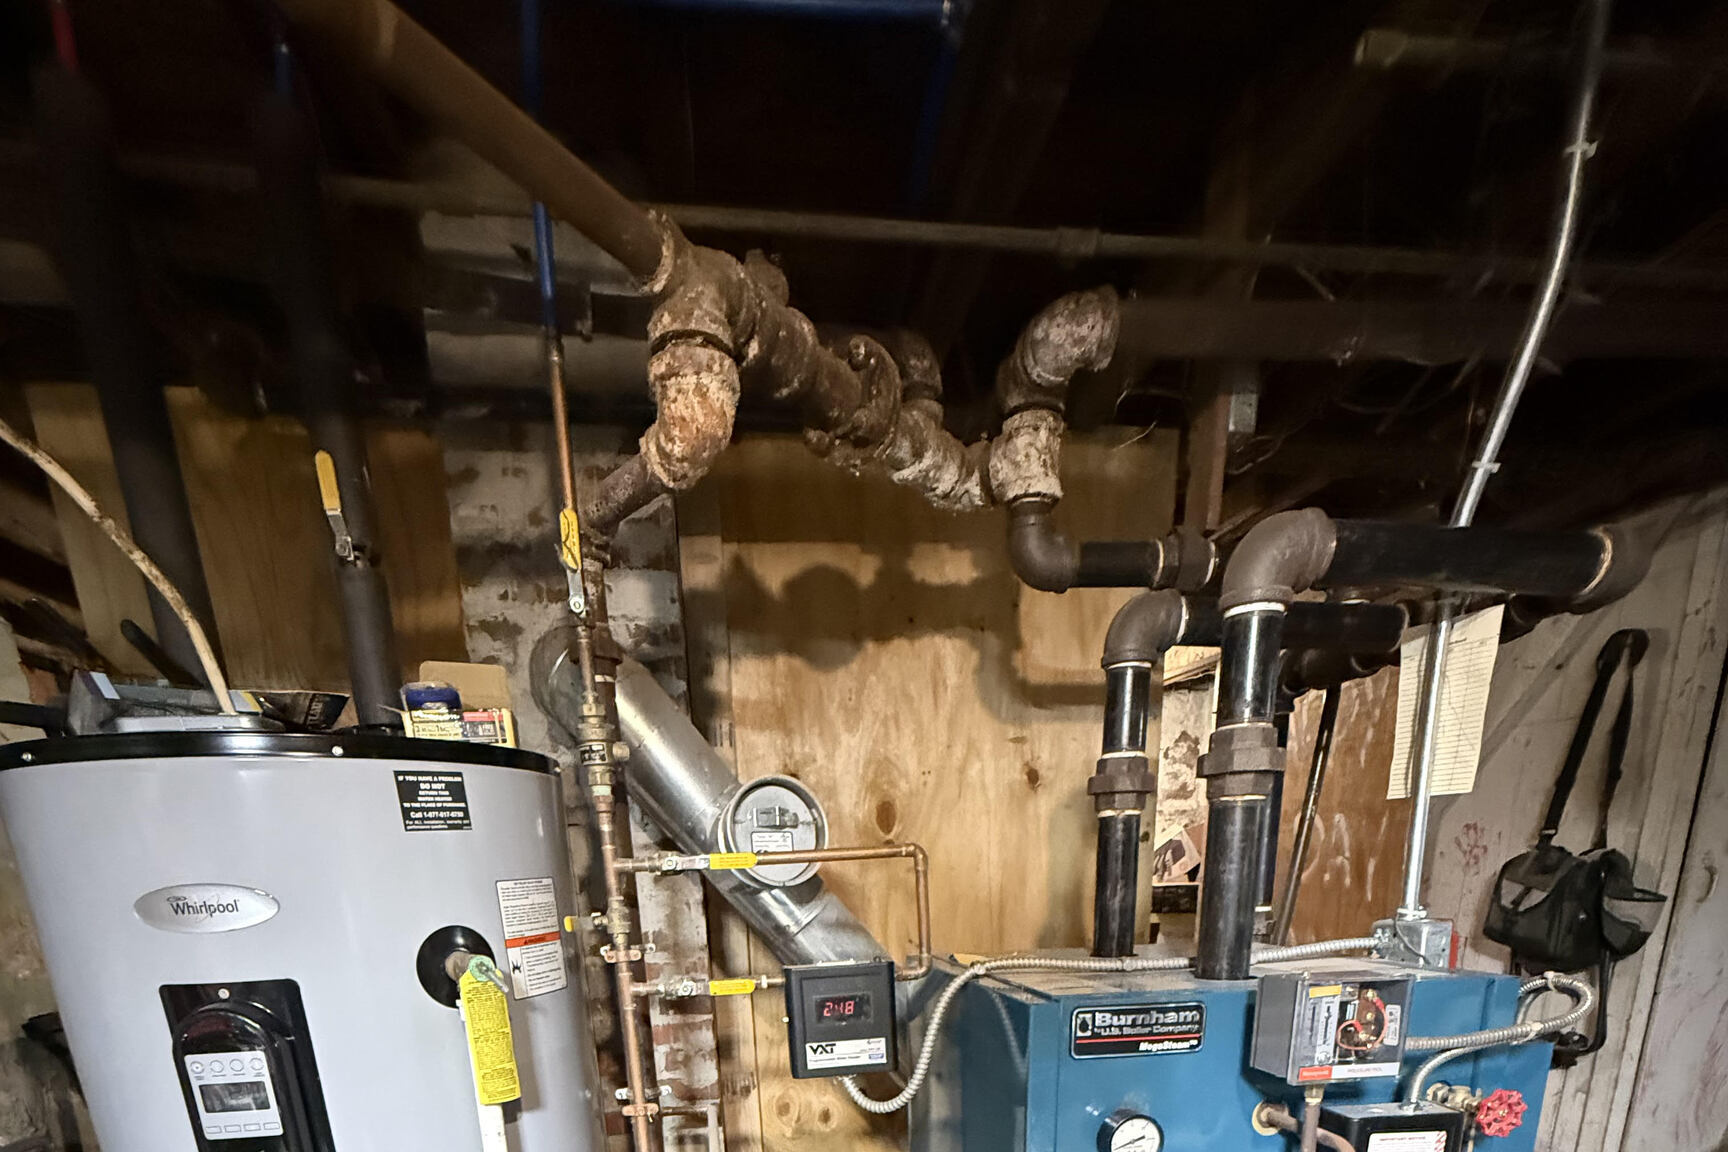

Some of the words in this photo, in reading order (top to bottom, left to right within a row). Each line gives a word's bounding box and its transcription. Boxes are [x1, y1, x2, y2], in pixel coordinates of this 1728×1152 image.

[170, 899, 239, 918] Whirlpool
[1095, 1010, 1200, 1027] Burnham
[1122, 1026, 1152, 1035] Boiler
[809, 1043, 836, 1055] VXT
